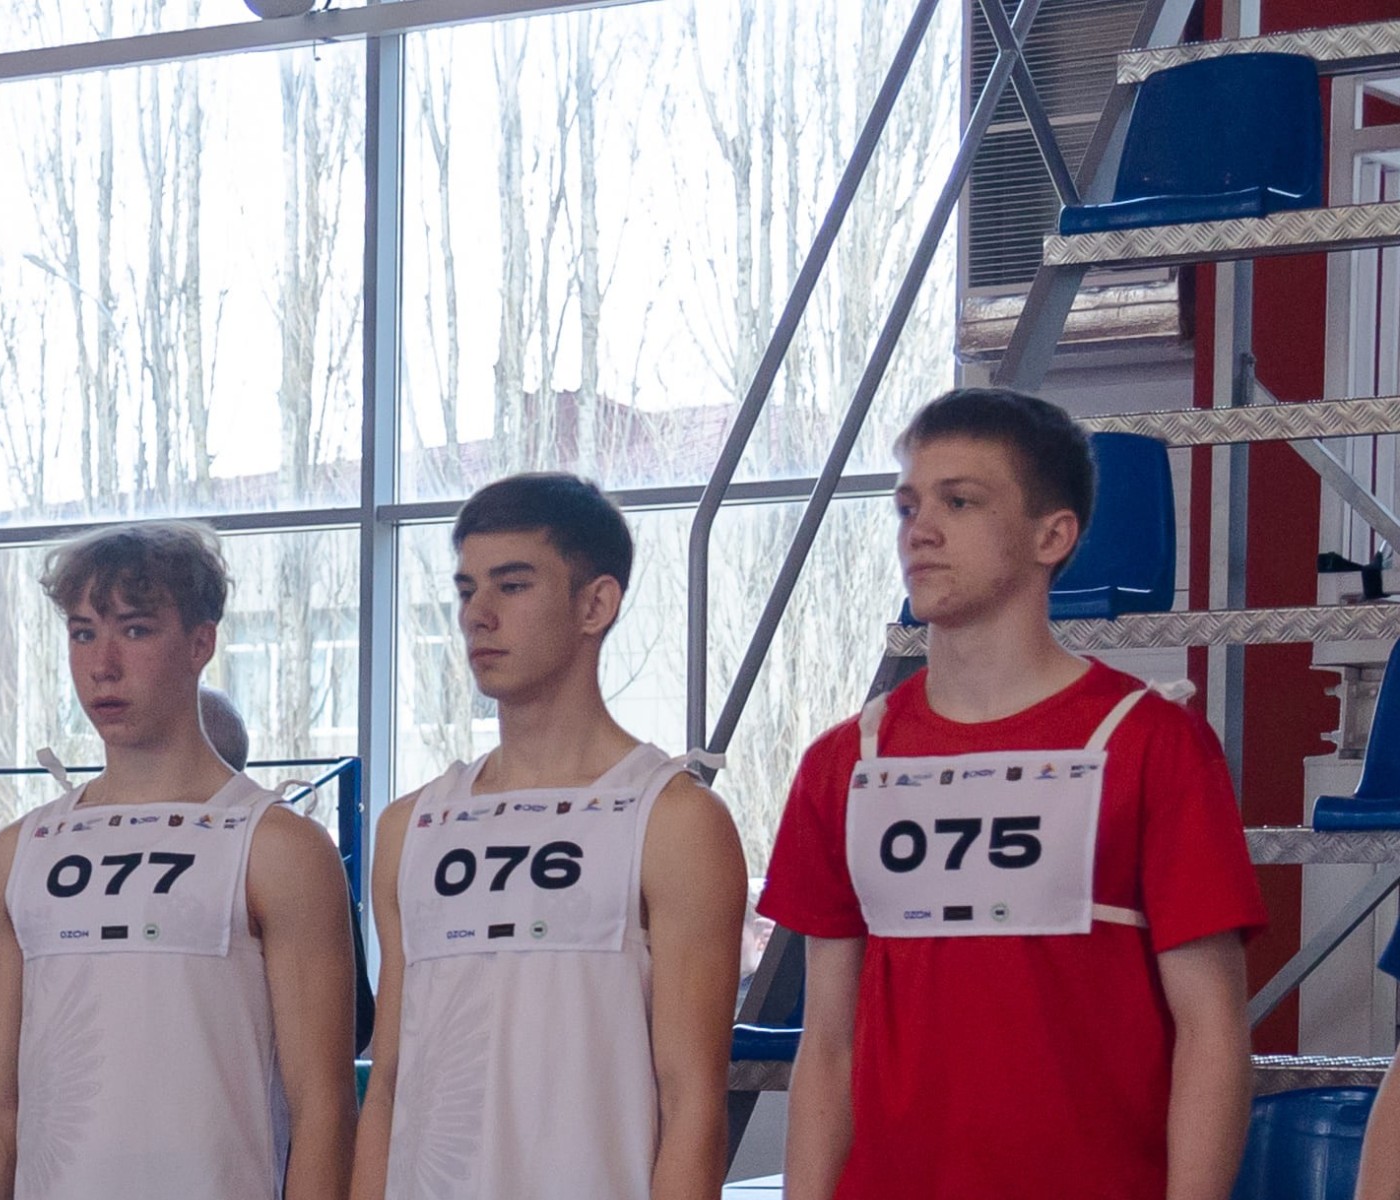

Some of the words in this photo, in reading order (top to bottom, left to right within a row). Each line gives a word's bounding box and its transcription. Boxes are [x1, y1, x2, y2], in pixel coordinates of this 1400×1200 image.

[434, 841, 584, 897] 076
[880, 815, 1042, 873] 075
[46, 852, 196, 898] 077
